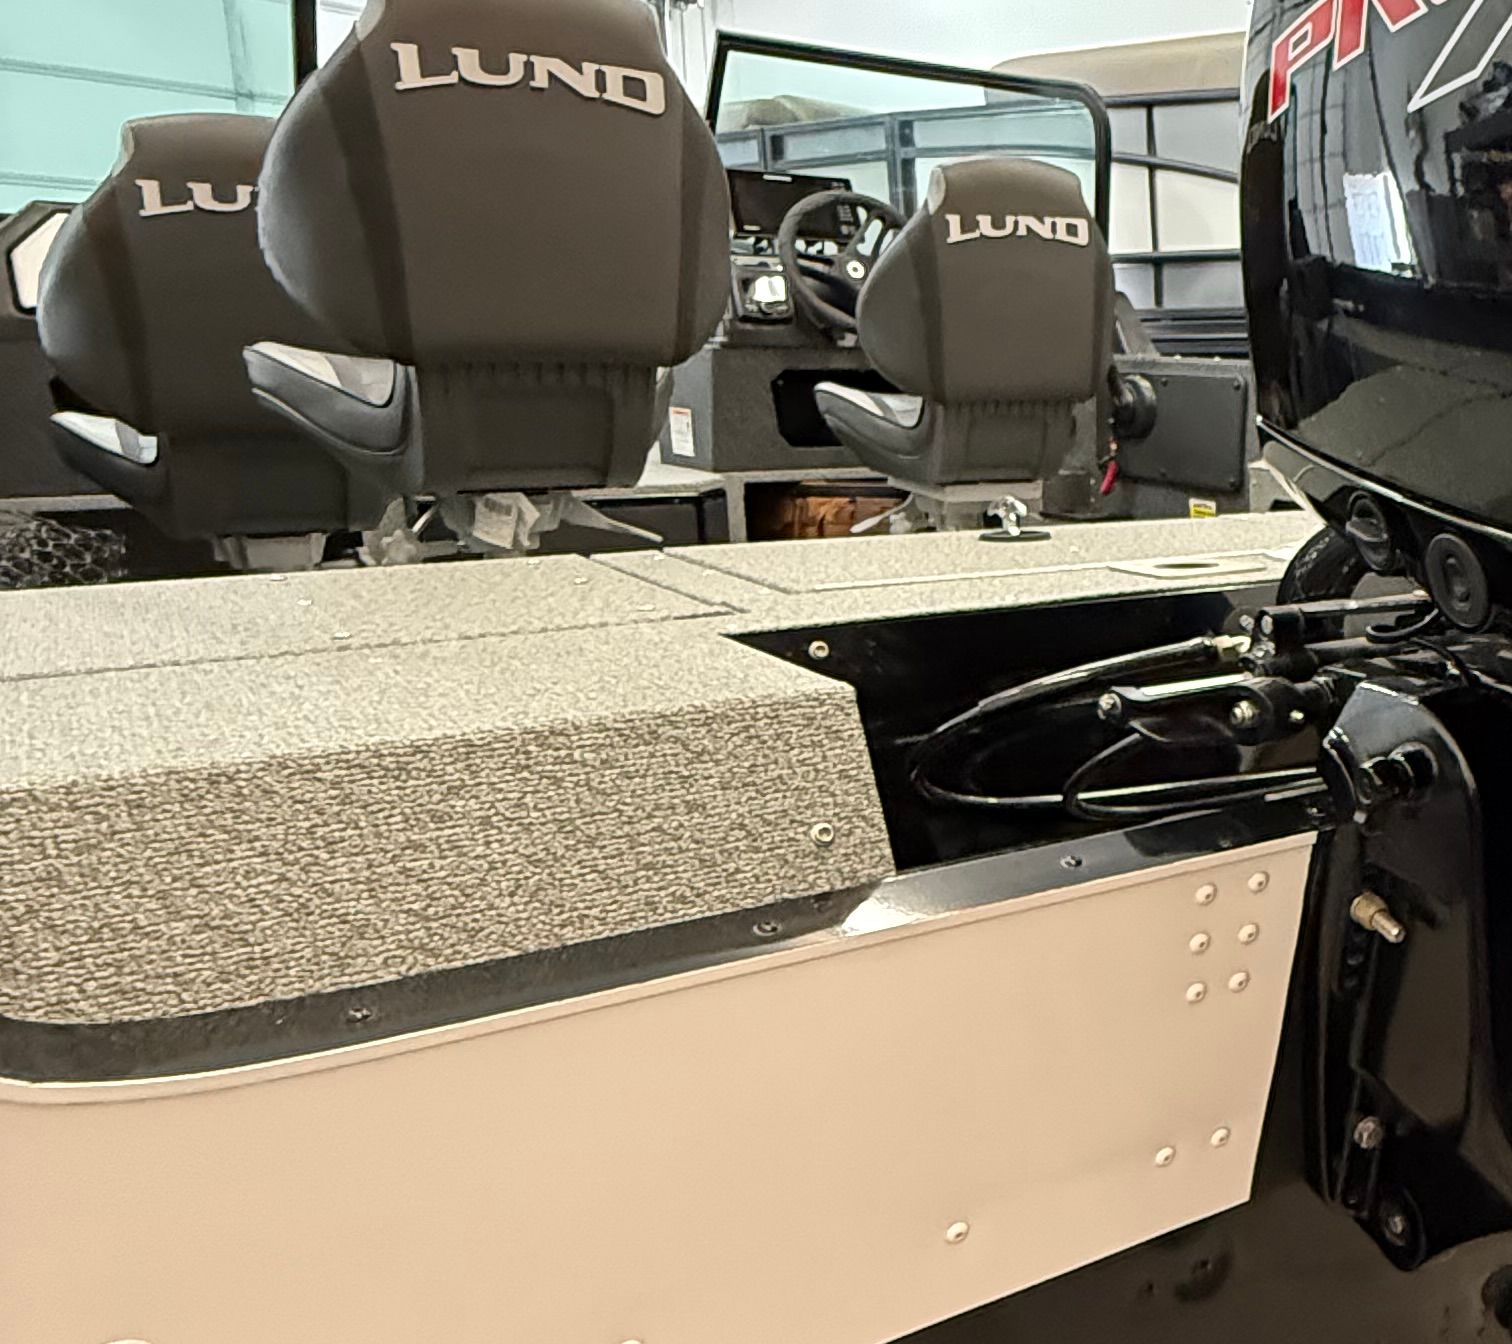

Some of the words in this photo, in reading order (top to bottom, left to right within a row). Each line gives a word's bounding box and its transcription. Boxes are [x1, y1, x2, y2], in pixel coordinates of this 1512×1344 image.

[390, 43, 667, 115] LUND
[134, 178, 260, 218] LU
[945, 213, 1089, 246] LUND
